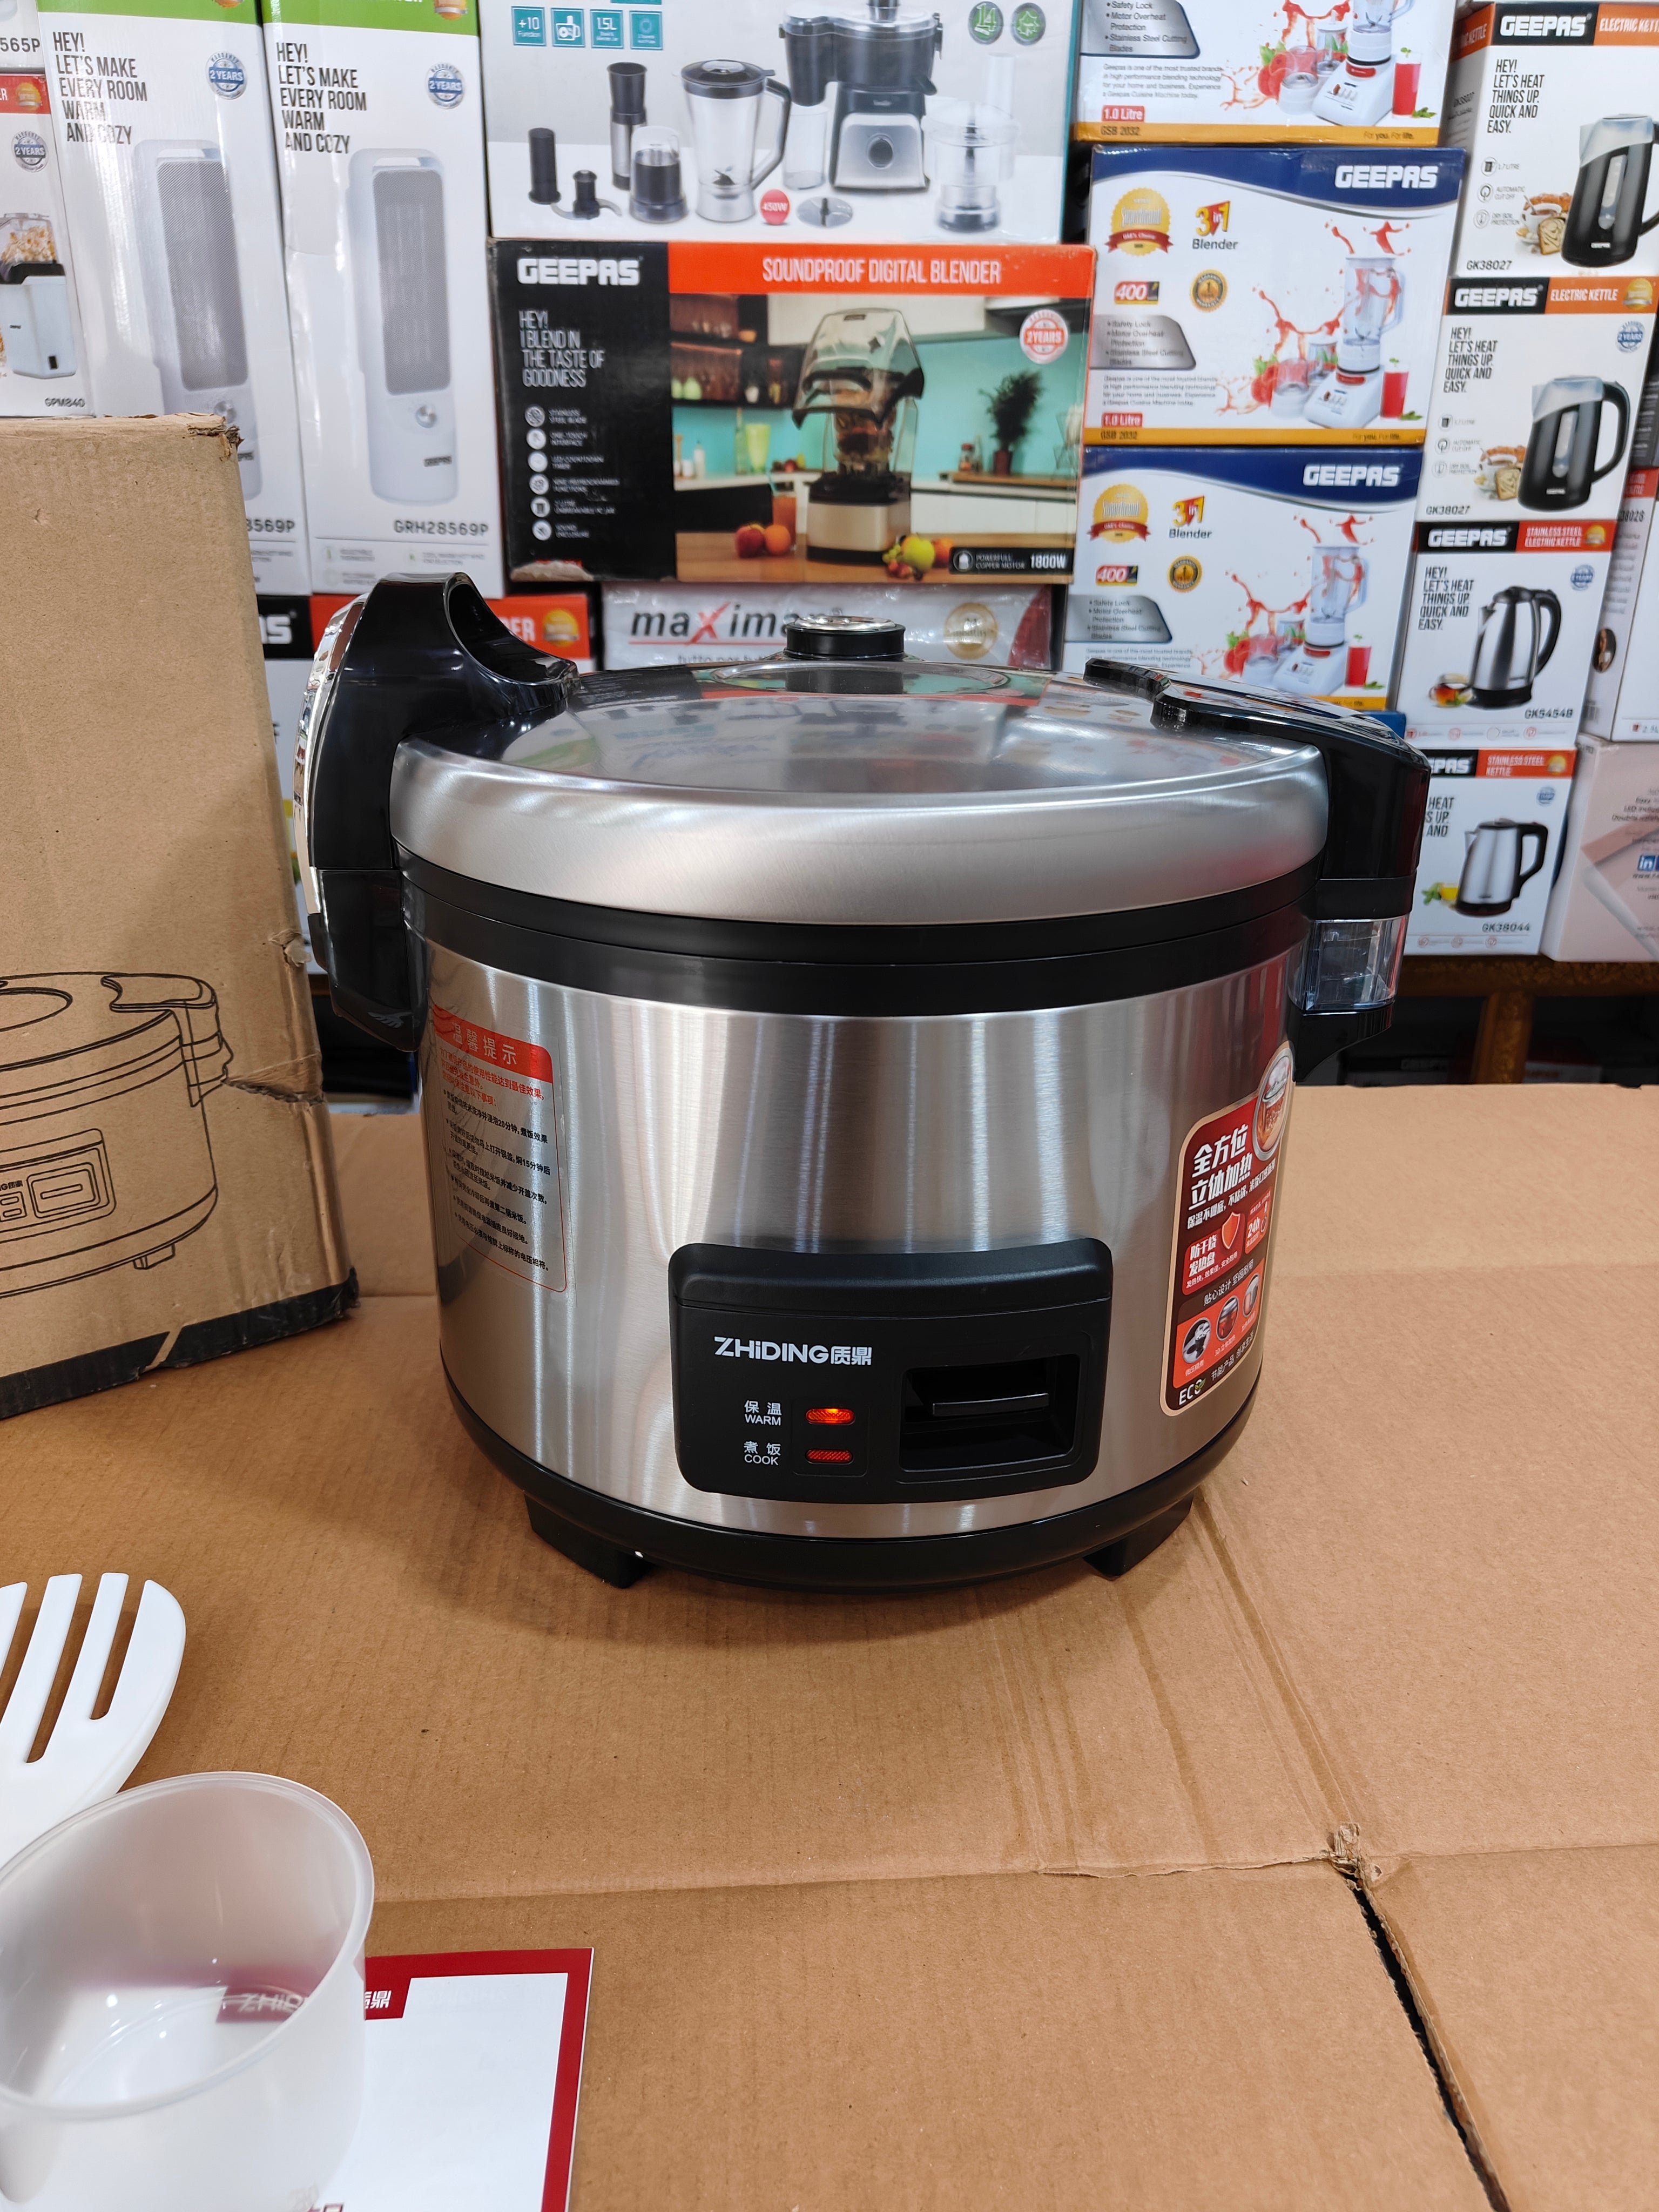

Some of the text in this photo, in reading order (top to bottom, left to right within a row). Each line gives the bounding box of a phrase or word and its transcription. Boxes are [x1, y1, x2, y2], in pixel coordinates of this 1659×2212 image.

[1111, 2, 1134, 10] Safety
[1110, 23, 1146, 31] Protection
[1500, 15, 1586, 37] GEEPAS
[1600, 18, 1638, 32] ELECTRIC
[52, 31, 85, 52] HEY!
[1109, 33, 1188, 44] Stainless Steel Cutting
[276, 42, 308, 64] HEY!
[1109, 44, 1133, 52] Blades
[56, 55, 138, 78] LET'S MAKE
[1495, 58, 1518, 73] HEY!
[210, 70, 244, 82] 2 YEARS
[278, 65, 359, 89] LET'S MAKE
[1493, 75, 1545, 89] LET'S HEAT
[59, 77, 148, 102] EVERY ROOM
[436, 81, 462, 92] YEARS
[280, 87, 367, 111] EVERY ROOM
[1492, 90, 1540, 104] THINGS UP.
[62, 99, 106, 122] WARM
[1104, 109, 1143, 120] 1.0 Litre
[1489, 105, 1539, 119] QUICK AND
[282, 110, 325, 131] WARM
[1487, 119, 1512, 134] EASY.
[66, 123, 132, 145] AND COZY
[1101, 125, 1140, 136] GSB 2032
[285, 132, 351, 155] AND COZY
[15, 146, 45, 157] 2 YEARS
[1334, 165, 1439, 189] GEEPAS
[1195, 207, 1211, 237] 3
[1192, 238, 1238, 250] Blender
[517, 258, 640, 286] GEEPAS
[762, 258, 1001, 285] SOUNDPROOF DIGITAL BLENDER
[1466, 260, 1513, 271] GK38027
[1116, 283, 1148, 301] 400
[1454, 287, 1538, 308] GEEPAS
[1550, 288, 1618, 302] ELECTRIC KETTLE
[518, 310, 549, 329] HEY!
[526, 330, 567, 349] BLEND
[1034, 329, 1062, 344] YEARS
[1451, 326, 1472, 340] HEY!
[1448, 340, 1499, 353] LET'S HEAT
[522, 349, 605, 369] THE TASTE OF
[1447, 354, 1494, 367] THINGS UP.
[522, 368, 588, 388] GOODNESS
[1445, 368, 1493, 380] QUICK AND
[1442, 380, 1468, 394] EASY.
[44, 397, 85, 408] GPM840
[1303, 464, 1400, 487] GEEPAS
[393, 519, 489, 537] GRH28569P
[1169, 528, 1212, 539] Blender
[1427, 528, 1508, 548] GEEPAS
[1030, 552, 1067, 569] 1800W
[1096, 568, 1127, 583] 400
[1425, 567, 1447, 579] HEY!
[1423, 579, 1474, 592] LET'S HEAT
[1422, 593, 1470, 605] THINGS UP.
[1420, 606, 1469, 619] QUICK AND
[1418, 619, 1444, 631] EASY.
[1428, 797, 1455, 810] HEAT
[1426, 825, 1448, 837] AND
[1192, 1124, 1249, 1177] 全方位
[1189, 1152, 1253, 1210] 立体加热
[1190, 1235, 1217, 1260] 防干烧
[744, 1400, 782, 1417] 保温
[745, 1413, 782, 1427] WARM
[744, 1441, 781, 1456] 煮饭
[744, 1453, 779, 1466] COOK
